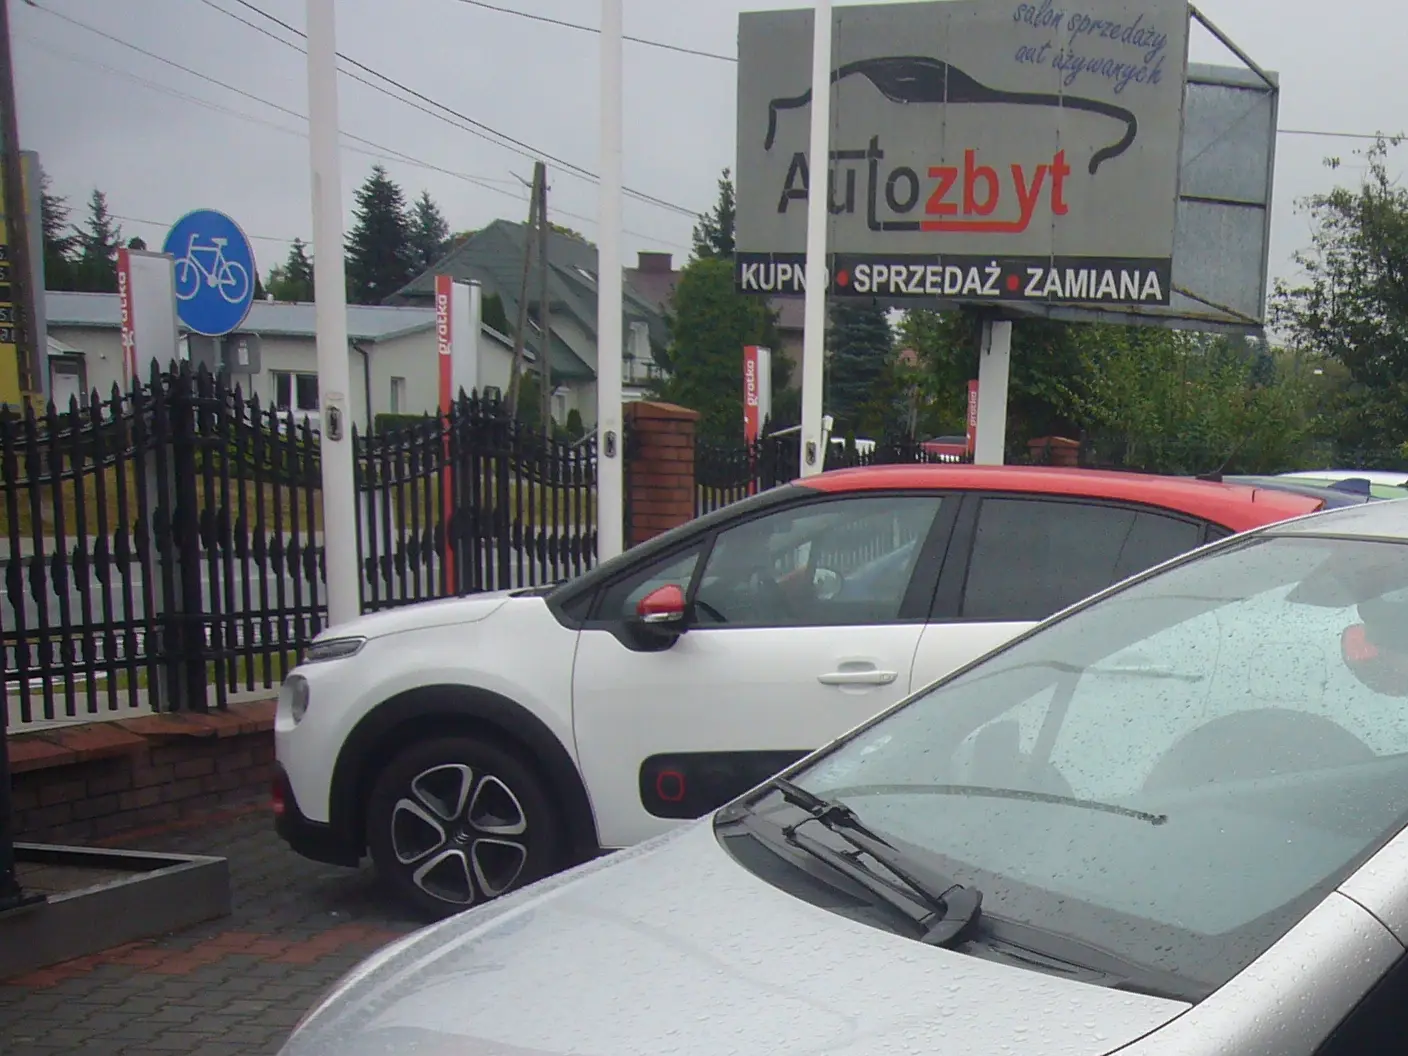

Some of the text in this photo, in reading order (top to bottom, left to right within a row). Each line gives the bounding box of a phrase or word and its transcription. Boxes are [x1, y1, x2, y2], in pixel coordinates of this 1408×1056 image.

[1013, 0, 1167, 63] salon sprzedaży
[1015, 40, 1165, 94] aut używanych
[777, 134, 1071, 232] Autozbyt
[741, 260, 1163, 300] KUPN SPRZEDAŻ ZAMIANA
[437, 294, 452, 355] gratka
